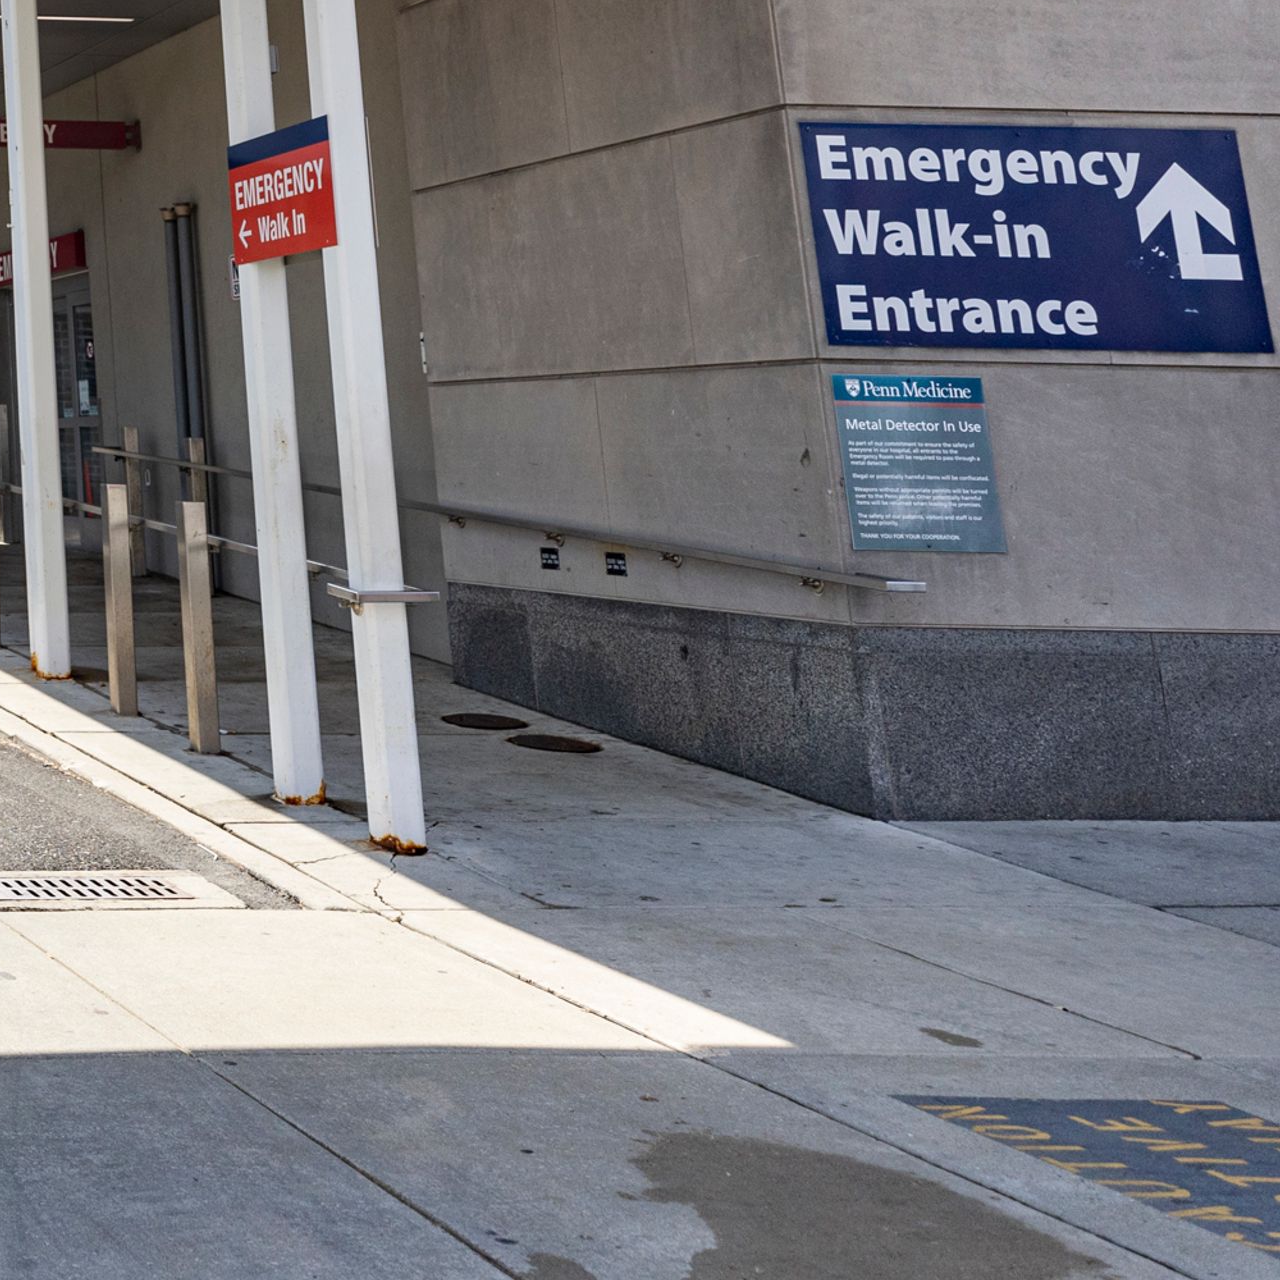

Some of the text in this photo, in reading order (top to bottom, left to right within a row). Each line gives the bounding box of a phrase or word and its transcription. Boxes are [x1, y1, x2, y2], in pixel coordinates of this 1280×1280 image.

[234, 157, 325, 212] EMERGENCY
[815, 134, 1141, 200] Emergency
[257, 210, 307, 243] Walk In
[823, 207, 1051, 259] Walk-in
[835, 283, 1098, 336] Entrance
[862, 380, 973, 400] Penn Medicine
[845, 418, 982, 434] Metal Detector In Use
